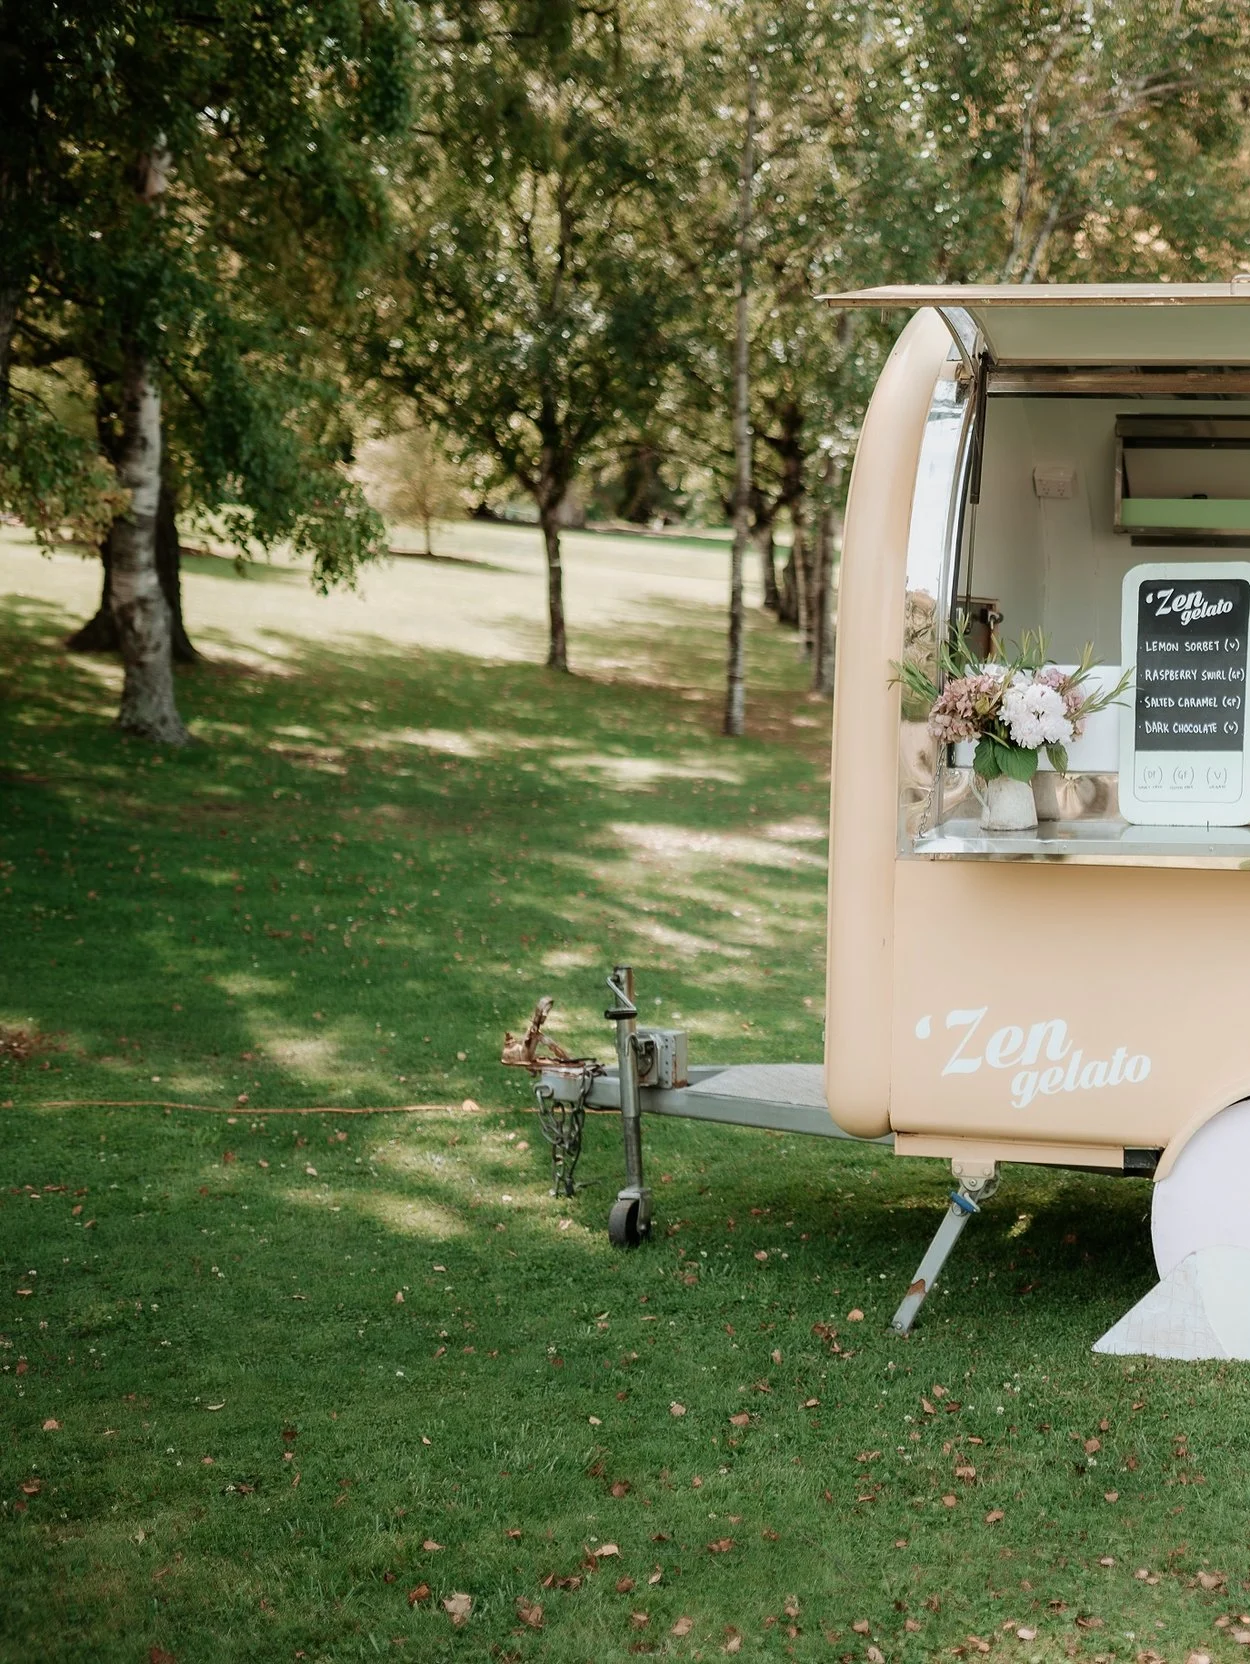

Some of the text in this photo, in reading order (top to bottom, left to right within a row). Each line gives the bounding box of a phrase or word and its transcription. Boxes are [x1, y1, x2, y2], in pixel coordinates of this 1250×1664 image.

[1180, 598, 1234, 626] gelato
[1145, 641, 1179, 652] LEMON
[1184, 640, 1220, 652] SORBET
[1145, 669, 1198, 681] RASPBERRY
[1201, 670, 1227, 681] SWIRL
[1144, 696, 1175, 708] SALTED
[1177, 697, 1218, 708] CARAMEL
[1144, 720, 1170, 734] DARK
[1172, 722, 1217, 734] CHOCOLATE
[1010, 1047, 1151, 1109] gelato
